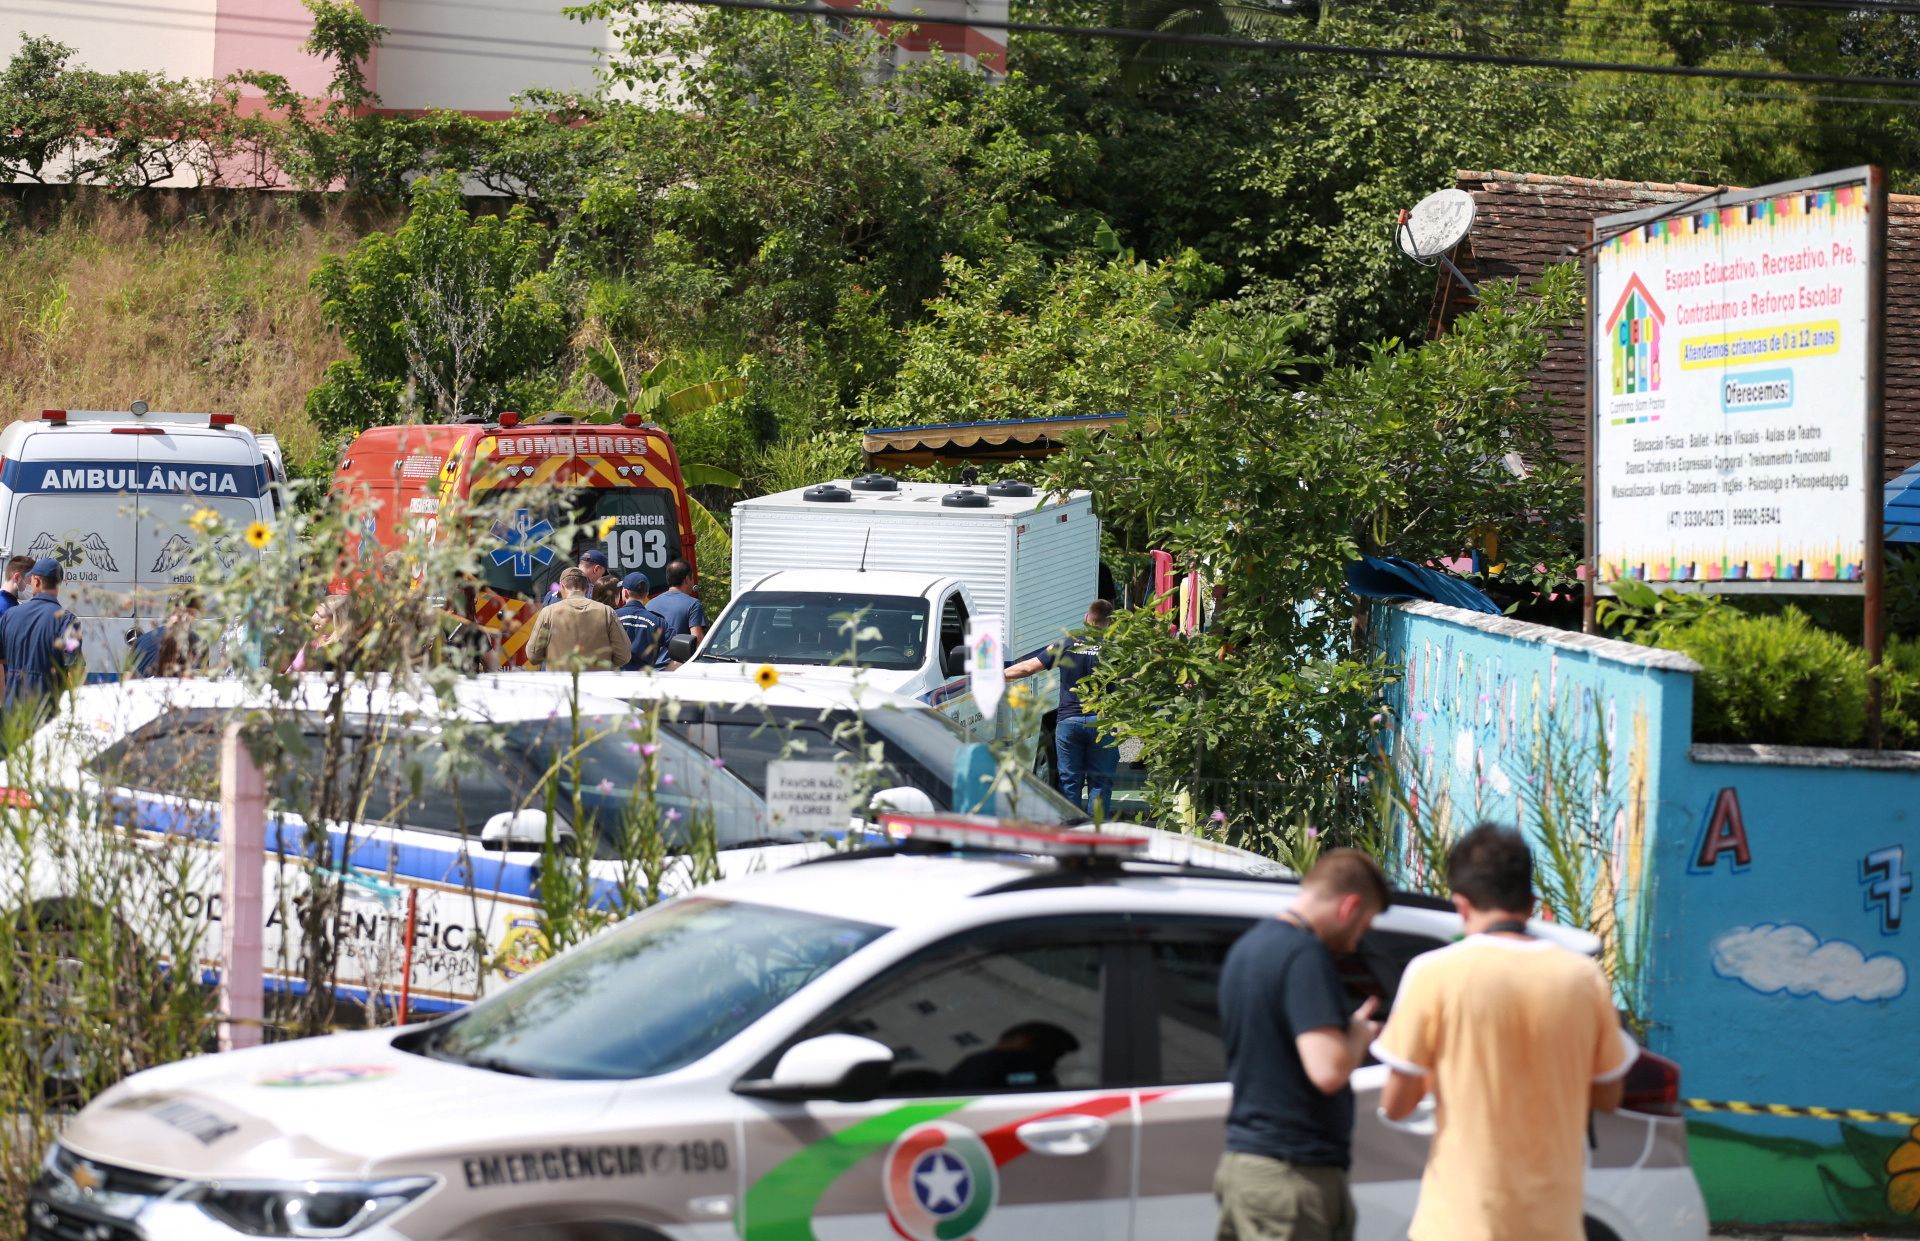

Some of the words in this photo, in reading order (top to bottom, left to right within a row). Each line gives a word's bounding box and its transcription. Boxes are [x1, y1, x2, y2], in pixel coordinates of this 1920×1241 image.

[1665, 268, 1701, 293] Espaço
[1704, 260, 1758, 284] Educativo,
[1762, 245, 1828, 276] Recreativo,
[1832, 239, 1856, 268] Pré,
[1741, 300, 1748, 317] e
[1751, 289, 1795, 317] Reforço
[1799, 283, 1842, 309] Escolar
[1683, 341, 1730, 361] Atendemos
[1731, 337, 1767, 357] crianças
[1769, 333, 1781, 351] de
[1783, 332, 1788, 349] 0
[1799, 329, 1810, 347] 12
[1812, 330, 1836, 346] anos
[1724, 383, 1789, 404] Oferecemos:
[497, 436, 648, 456] BOMBEIROS
[1787, 427, 1796, 441] de
[1797, 424, 1821, 440] Teatro
[1673, 462, 1677, 472] e
[1794, 448, 1831, 465] Funcional
[41, 466, 238, 493] AMBULÂNCIA
[603, 529, 667, 569] 193
[80, 571, 98, 581] Vida
[680, 1140, 728, 1172] 190
